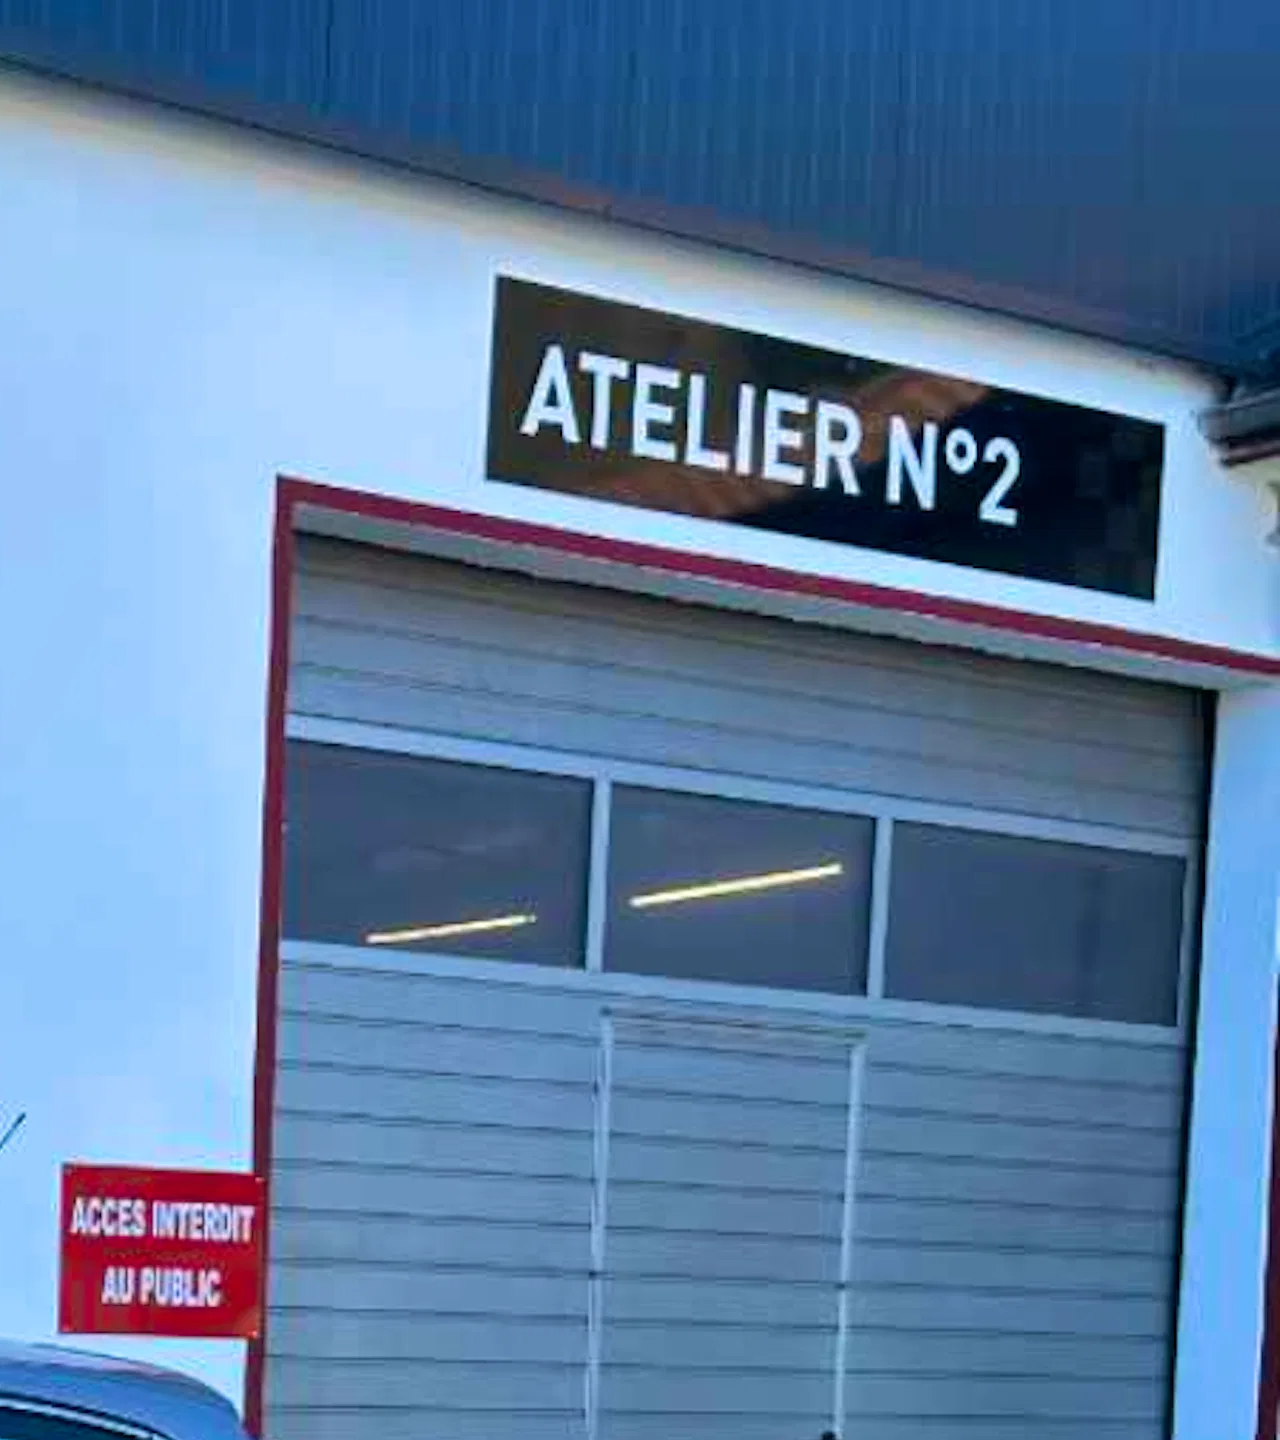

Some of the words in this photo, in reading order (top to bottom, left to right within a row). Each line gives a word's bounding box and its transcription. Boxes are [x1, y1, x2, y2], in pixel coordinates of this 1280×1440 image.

[519, 345, 861, 497] ATELIER
[70, 1196, 146, 1237] ACCES
[153, 1200, 255, 1242] INTERDIT
[101, 1266, 135, 1304] AU
[140, 1268, 221, 1307] PUBLIC
